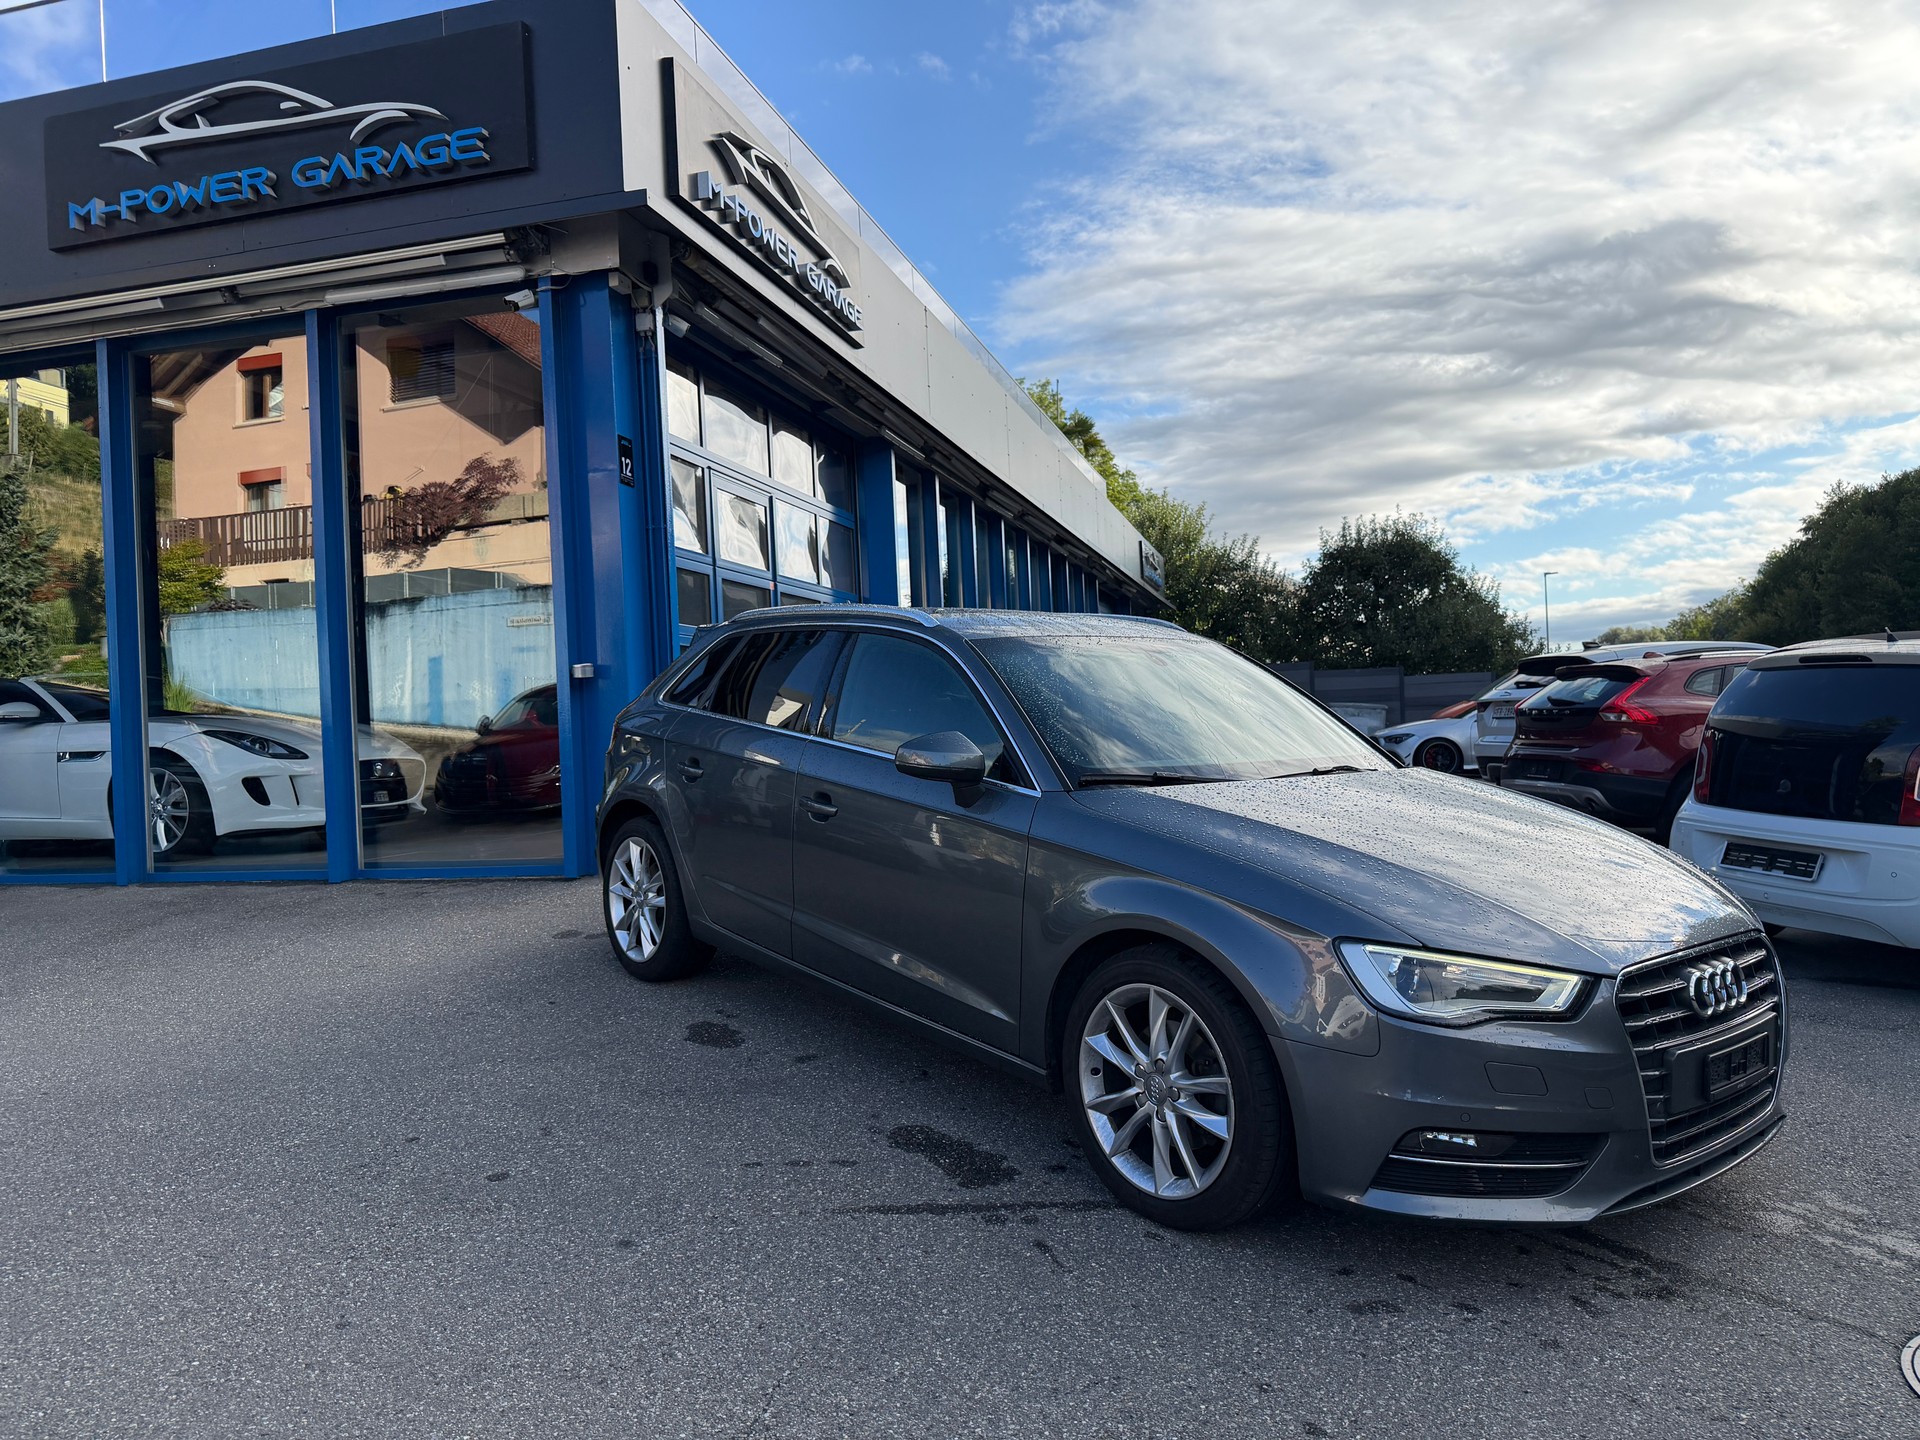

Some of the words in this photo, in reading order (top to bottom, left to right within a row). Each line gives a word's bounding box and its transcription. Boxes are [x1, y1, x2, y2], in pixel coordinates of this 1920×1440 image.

[68, 166, 275, 230] M-POWER
[291, 126, 487, 188] GARAGE
[702, 171, 800, 274] M-POWER
[805, 262, 864, 331] GARAGE
[621, 456, 632, 476] 12
